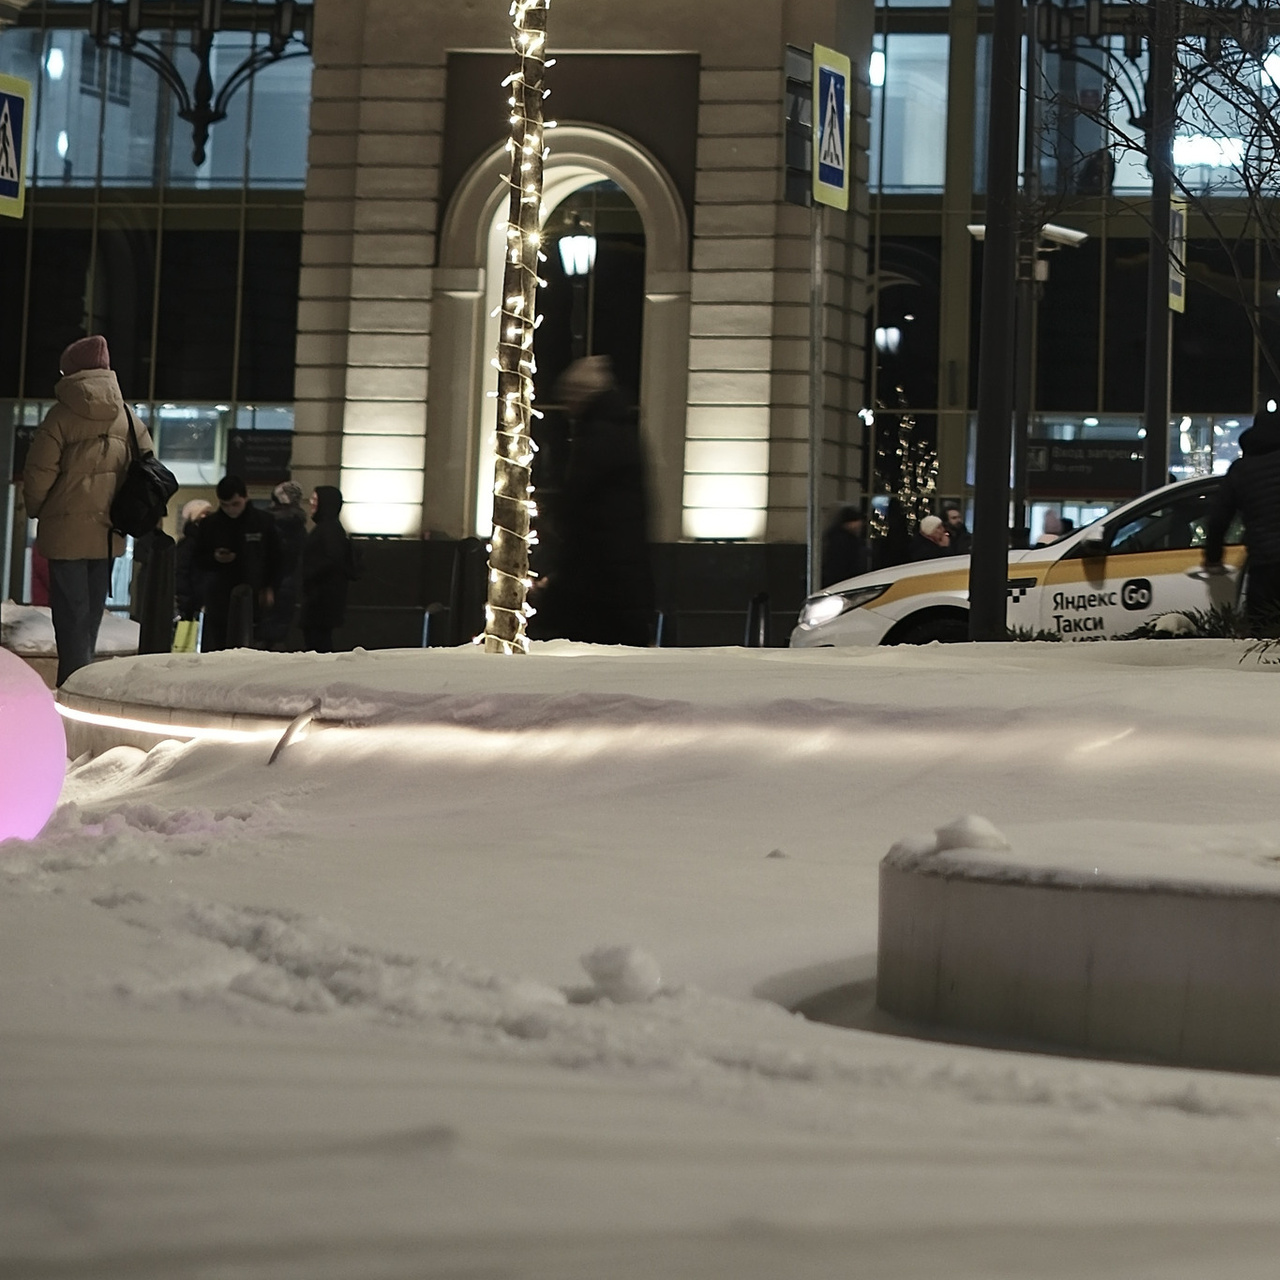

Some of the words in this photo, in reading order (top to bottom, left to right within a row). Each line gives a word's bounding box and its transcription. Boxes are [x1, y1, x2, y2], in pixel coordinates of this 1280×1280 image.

[1053, 592, 1117, 611] Яндекс
[1124, 585, 1150, 604] Go
[1052, 615, 1104, 633] Такси
